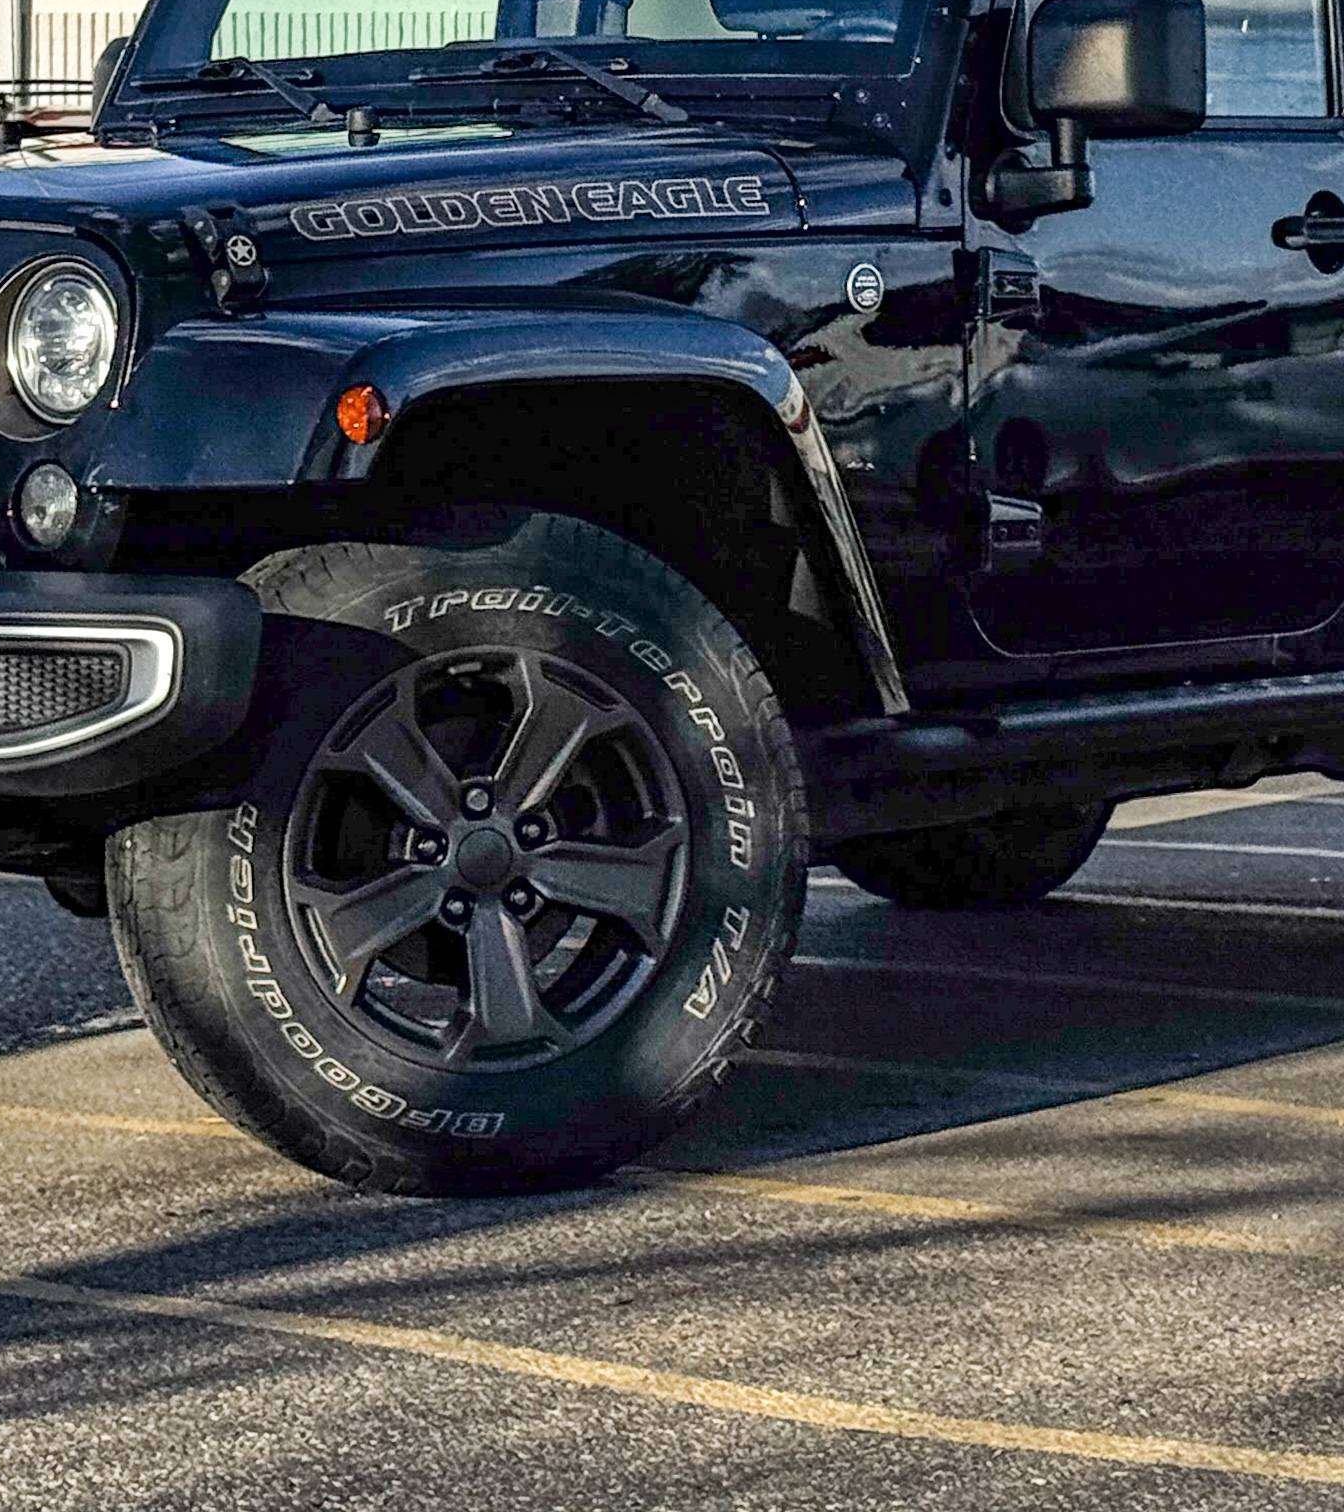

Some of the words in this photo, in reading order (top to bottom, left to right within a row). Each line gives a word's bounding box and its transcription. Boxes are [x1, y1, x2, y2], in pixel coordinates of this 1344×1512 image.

[290, 185, 571, 241] GOLDEN
[570, 175, 770, 222] EAGLE
[227, 801, 506, 1138] BFGoodrich
[384, 584, 754, 871] Trail-Terrain
[682, 905, 750, 1020] T/A
